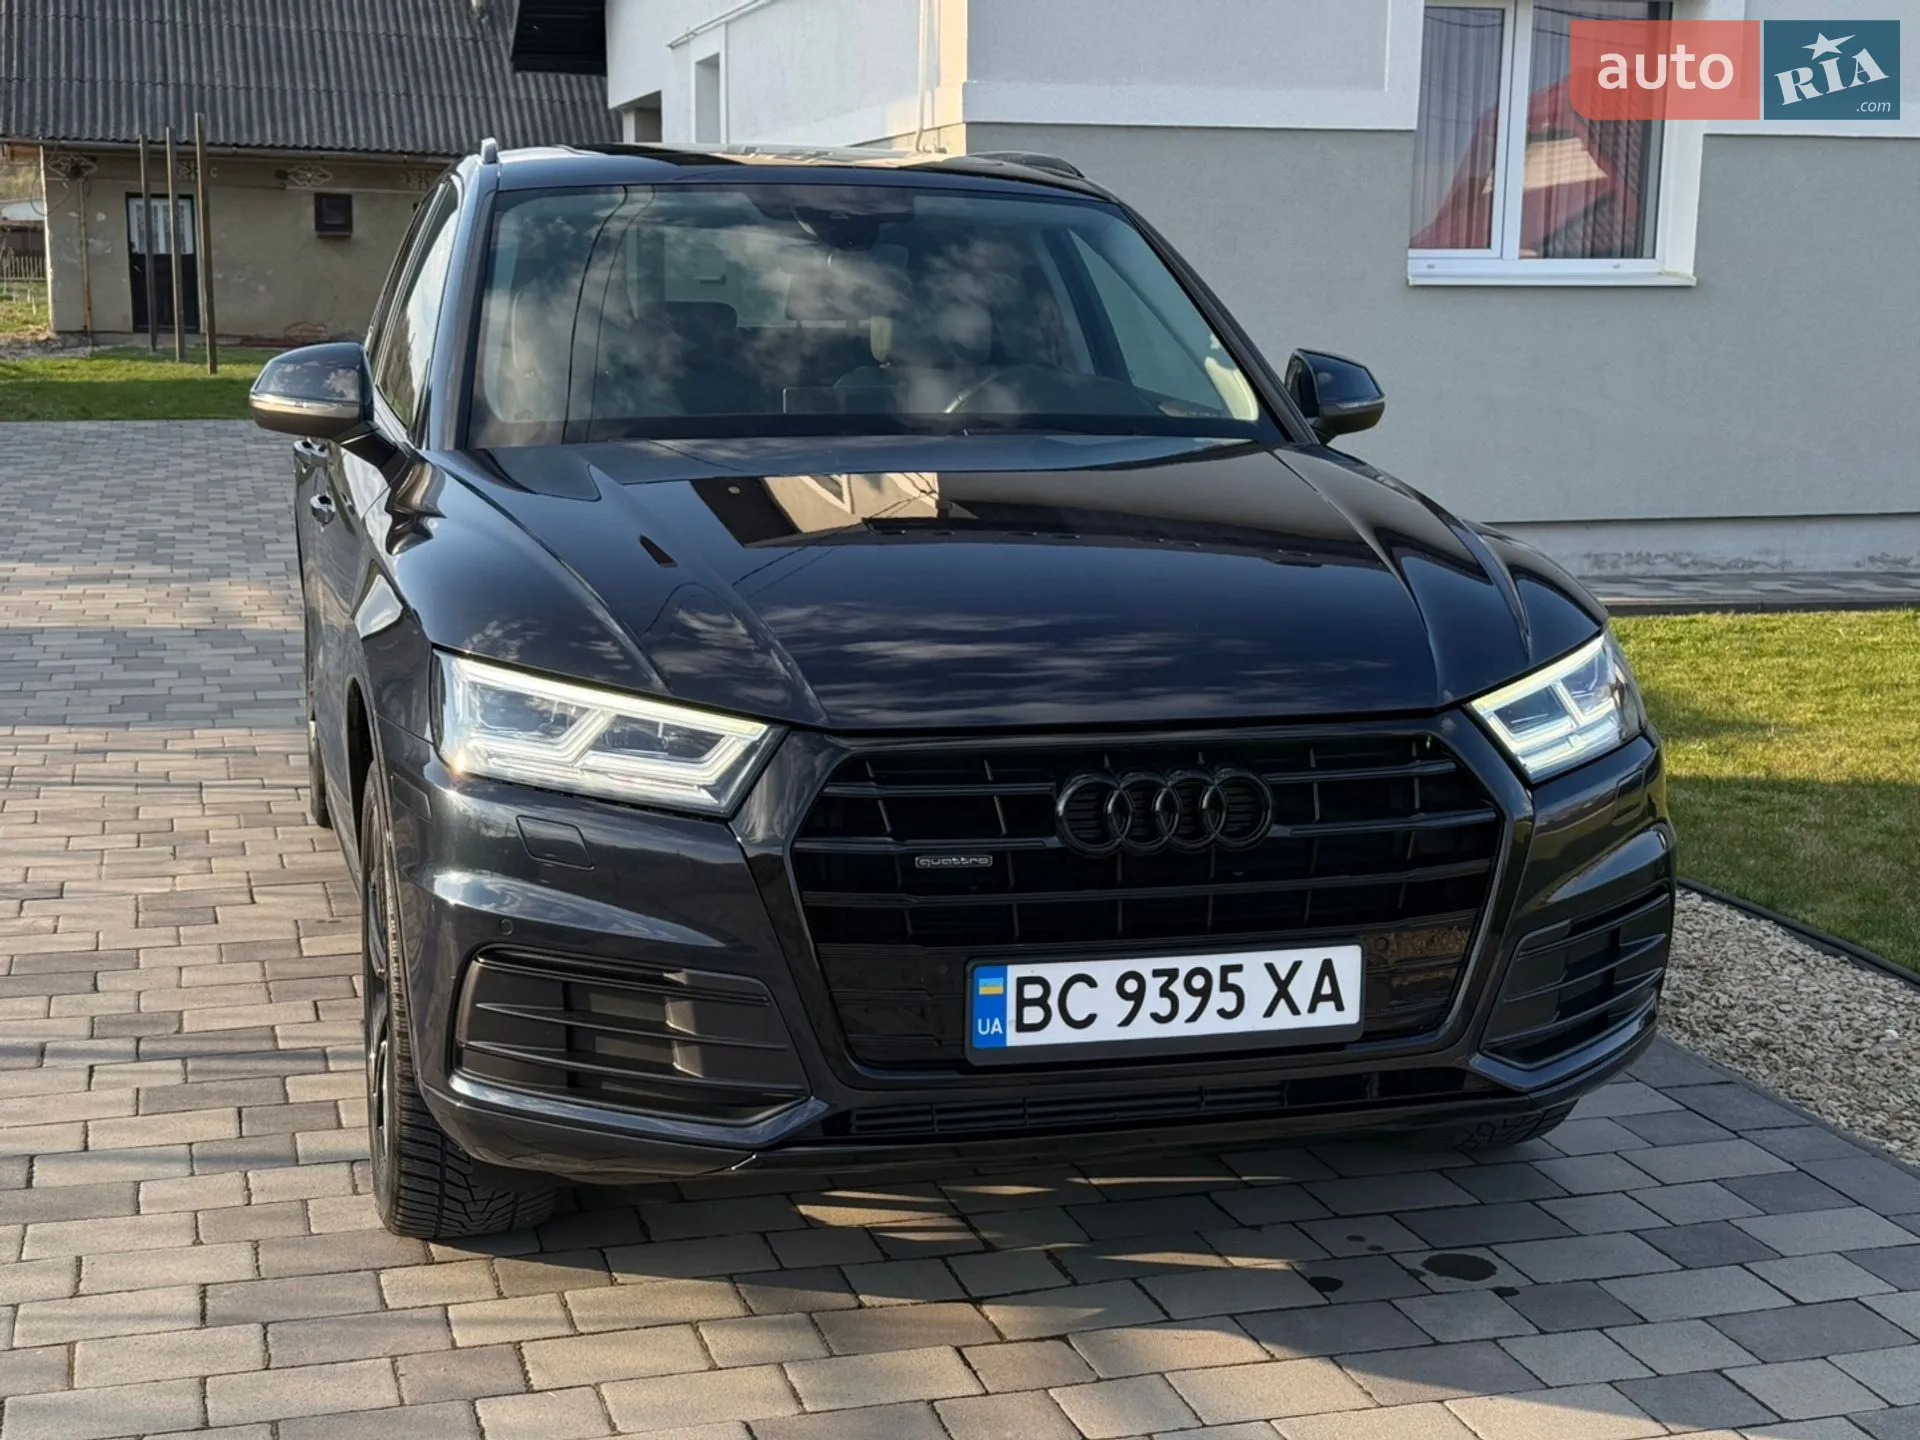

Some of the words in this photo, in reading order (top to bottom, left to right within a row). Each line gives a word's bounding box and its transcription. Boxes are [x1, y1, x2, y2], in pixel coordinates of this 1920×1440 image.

[919, 857, 989, 868] quattro
[1015, 973, 1098, 1033] BC
[1115, 963, 1246, 1027] 9395
[1262, 958, 1345, 1019] XA
[977, 1018, 1004, 1036] UA
